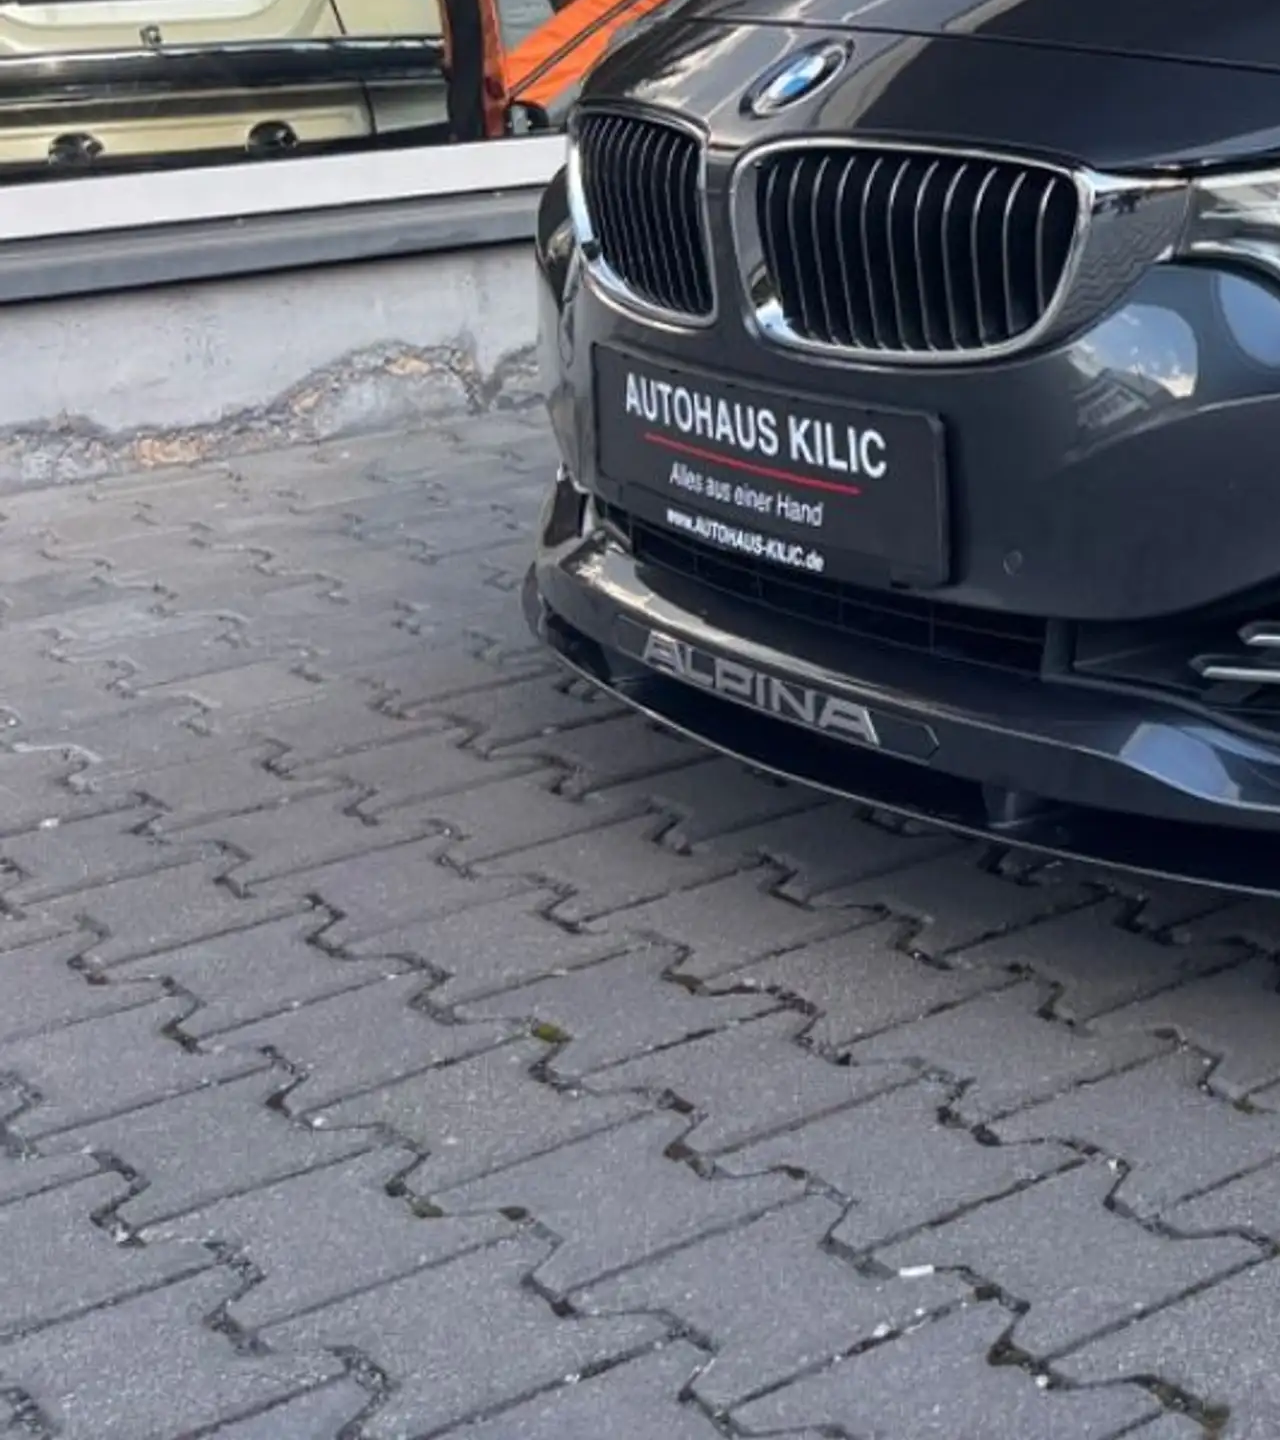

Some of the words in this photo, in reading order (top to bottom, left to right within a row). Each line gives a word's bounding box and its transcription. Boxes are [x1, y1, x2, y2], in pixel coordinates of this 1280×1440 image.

[625, 372, 779, 456] AUTOHAUS
[788, 415, 887, 478] KILIC
[669, 462, 704, 494] Alles
[706, 477, 732, 503] aus
[734, 483, 774, 513] einer
[776, 492, 824, 527] Hand
[666, 509, 825, 572] www.AUTOHAUS-KILIC.de
[643, 629, 880, 747] ALPINA
